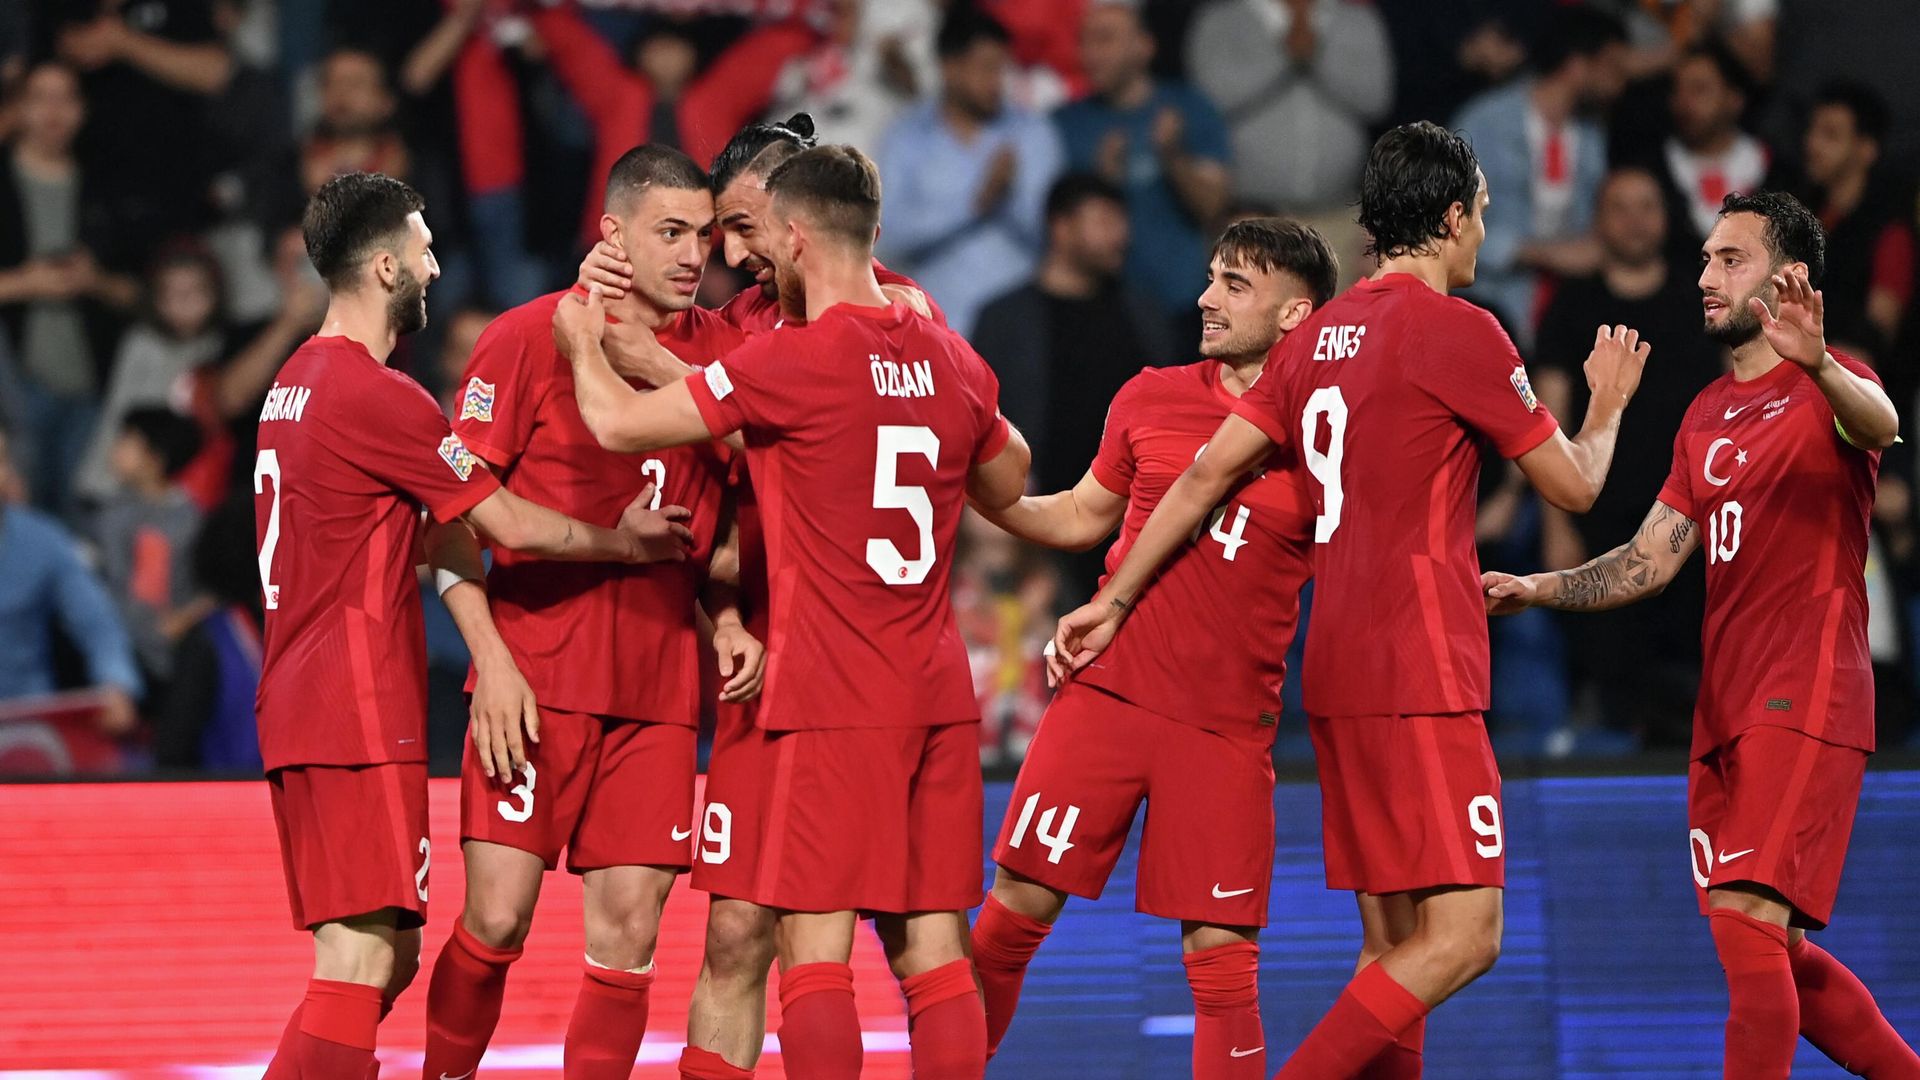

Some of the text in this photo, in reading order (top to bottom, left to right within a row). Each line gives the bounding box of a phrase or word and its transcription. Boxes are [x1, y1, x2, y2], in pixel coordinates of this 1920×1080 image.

[1313, 325, 1366, 360] ENES
[869, 354, 935, 398] ÖZCAN
[1301, 385, 1349, 543] 9
[254, 449, 281, 609] 2
[866, 425, 941, 585] 5
[1205, 504, 1251, 561] 4
[1709, 501, 1743, 565] 10
[497, 761, 537, 823] 3
[1008, 792, 1081, 865] 14
[1468, 795, 1503, 858] 9
[1689, 828, 1714, 888] 0
[415, 836, 431, 902] 2
